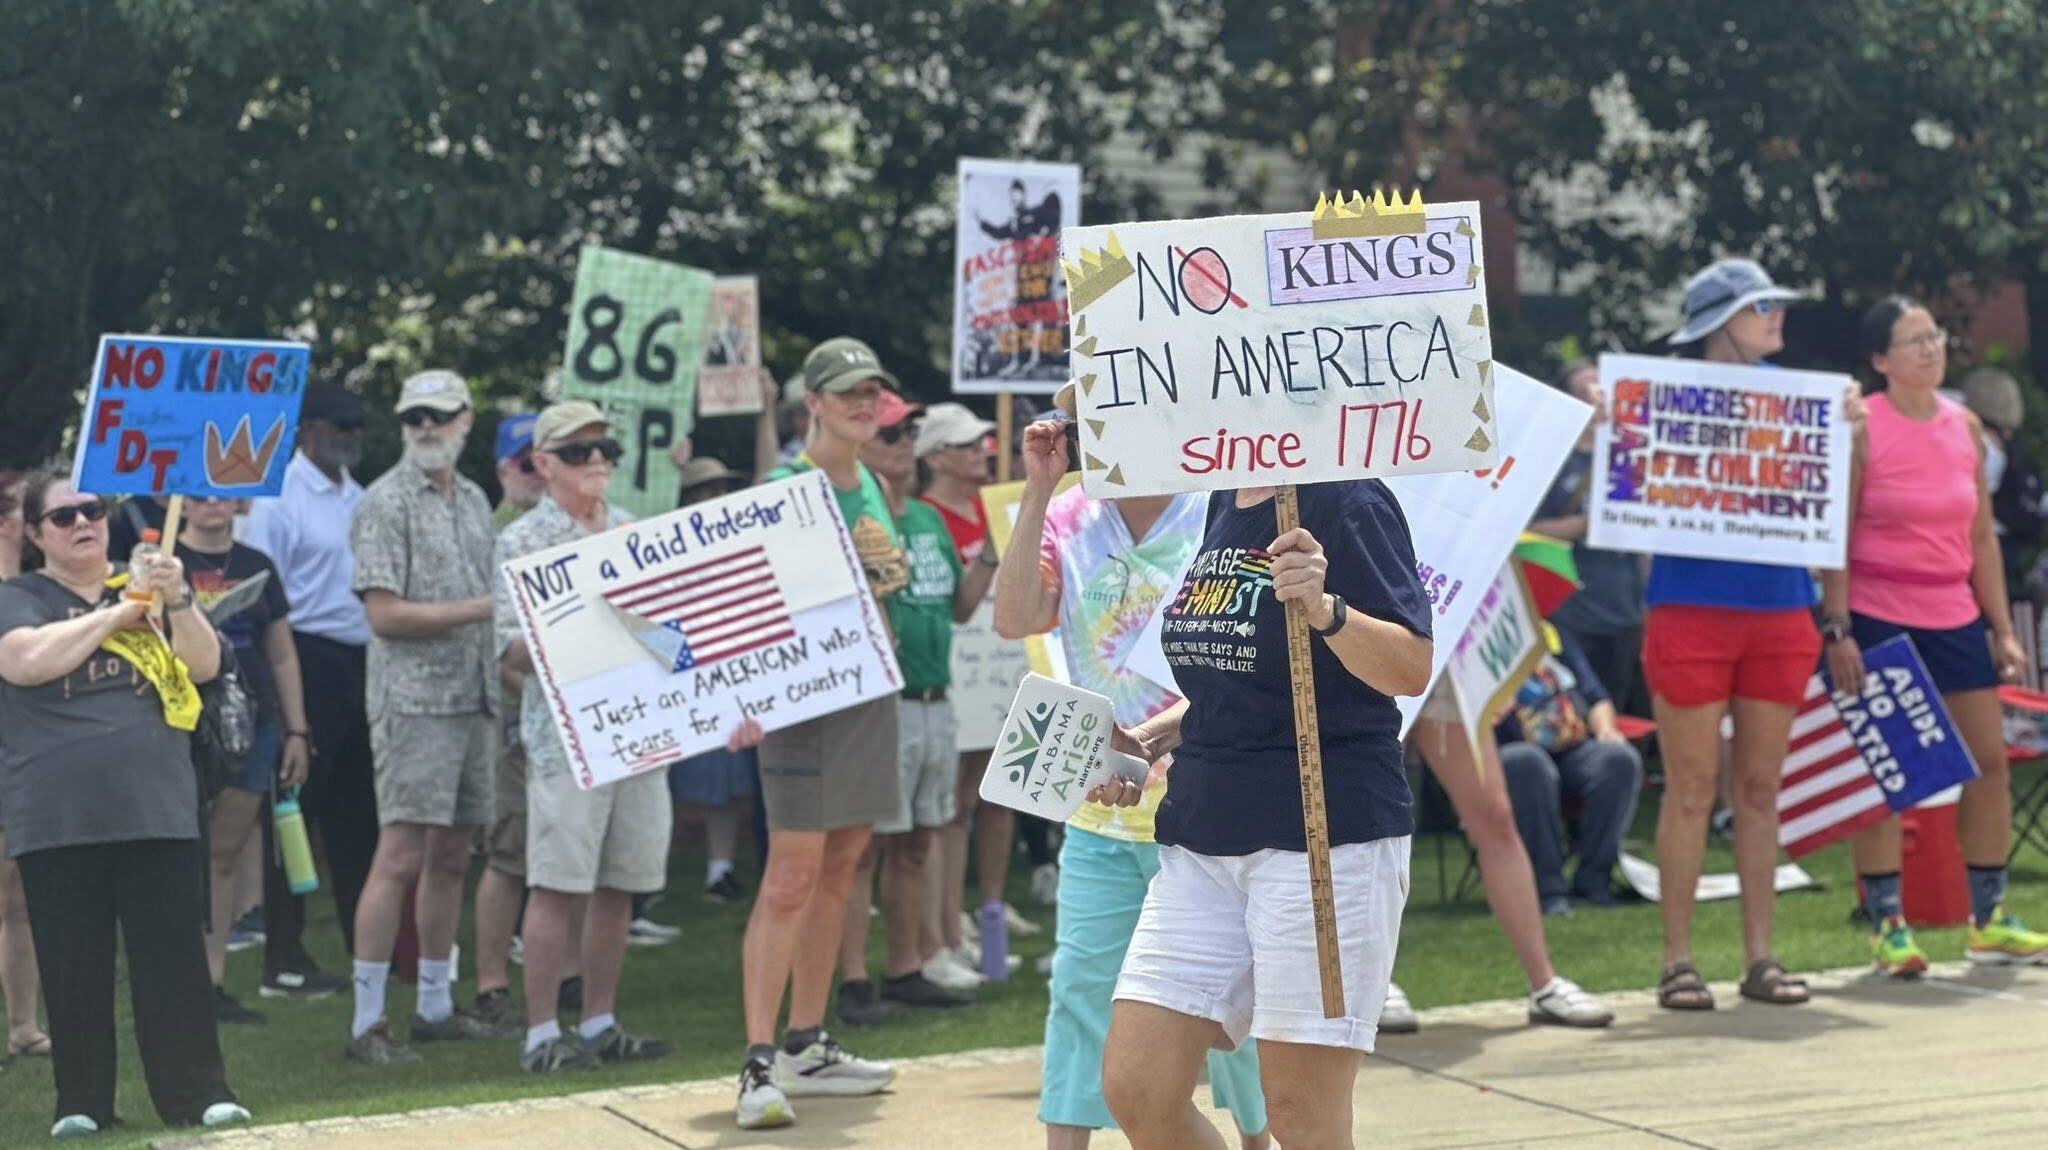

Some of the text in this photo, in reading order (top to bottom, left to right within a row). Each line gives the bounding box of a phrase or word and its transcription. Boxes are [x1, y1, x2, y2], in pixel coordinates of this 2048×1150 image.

[1137, 244, 1232, 321] NO
[1278, 231, 1457, 291] KINGS
[103, 345, 299, 395] NO KINGS
[575, 293, 682, 386] 86
[1092, 315, 1460, 409] IN AMERICA
[94, 400, 123, 443] F
[1180, 398, 1431, 474] since 1776
[1654, 383, 1831, 427] UNDERESTIMATE
[1655, 418, 1694, 445] THE
[115, 429, 147, 473] D
[150, 451, 177, 492] T
[1606, 378, 1651, 502] NEVER
[1648, 483, 1831, 521] MOVEMENT
[1707, 451, 1754, 486] CIVIL
[1758, 456, 1829, 493] RIGHTS
[522, 554, 579, 606] NOT
[600, 561, 619, 580] a
[626, 532, 687, 571] Paid
[580, 628, 862, 732] Just an AMERICAN who
[1211, 643, 1233, 656] SAYS
[1236, 646, 1257, 658] AND
[611, 664, 865, 766] fears for her country
[1863, 671, 1895, 718] NO
[1883, 667, 1945, 748] ABIDE
[1030, 700, 1078, 802] ALABAMA
[1051, 712, 1098, 801] Arise
[1078, 736, 1105, 788] alarise.org
